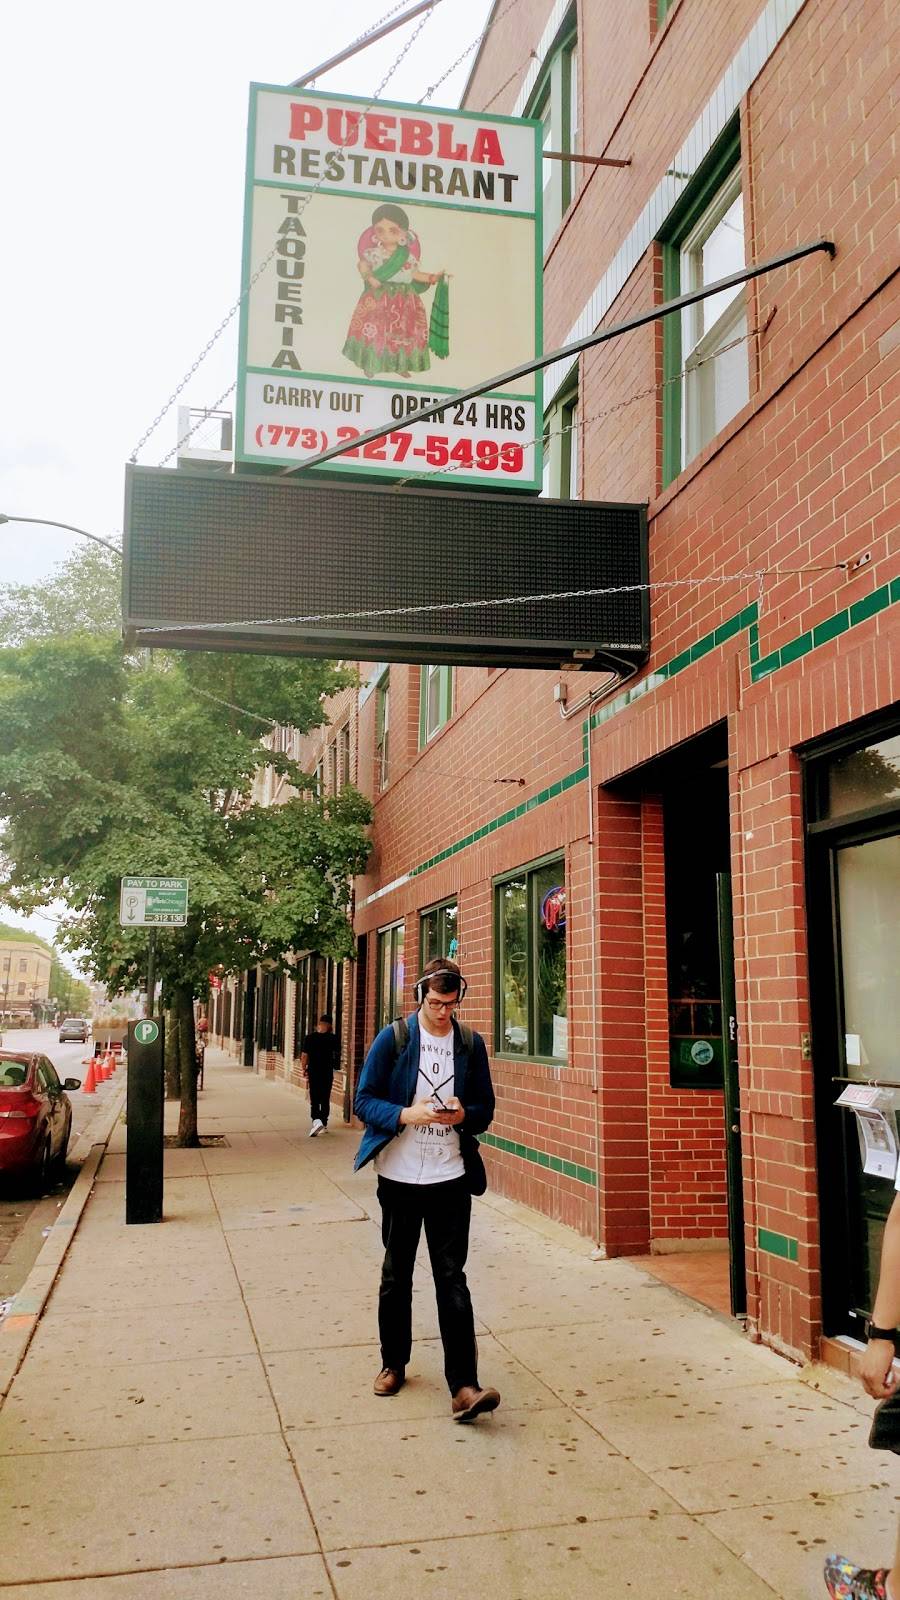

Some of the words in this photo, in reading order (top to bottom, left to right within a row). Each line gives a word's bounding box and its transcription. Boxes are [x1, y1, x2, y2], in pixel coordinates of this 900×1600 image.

[289, 102, 505, 166] PUEBLA
[273, 144, 519, 203] RESTAURANT
[272, 194, 307, 371] TAQUERIA
[263, 384, 324, 409] CARRY
[329, 391, 364, 413] OUT
[391, 394, 445, 424] OPEN
[453, 402, 478, 427] 24
[486, 404, 525, 432] HRS
[255, 423, 329, 453] (773)
[159, 880, 183, 888] PARK
[142, 1024, 153, 1040] P
